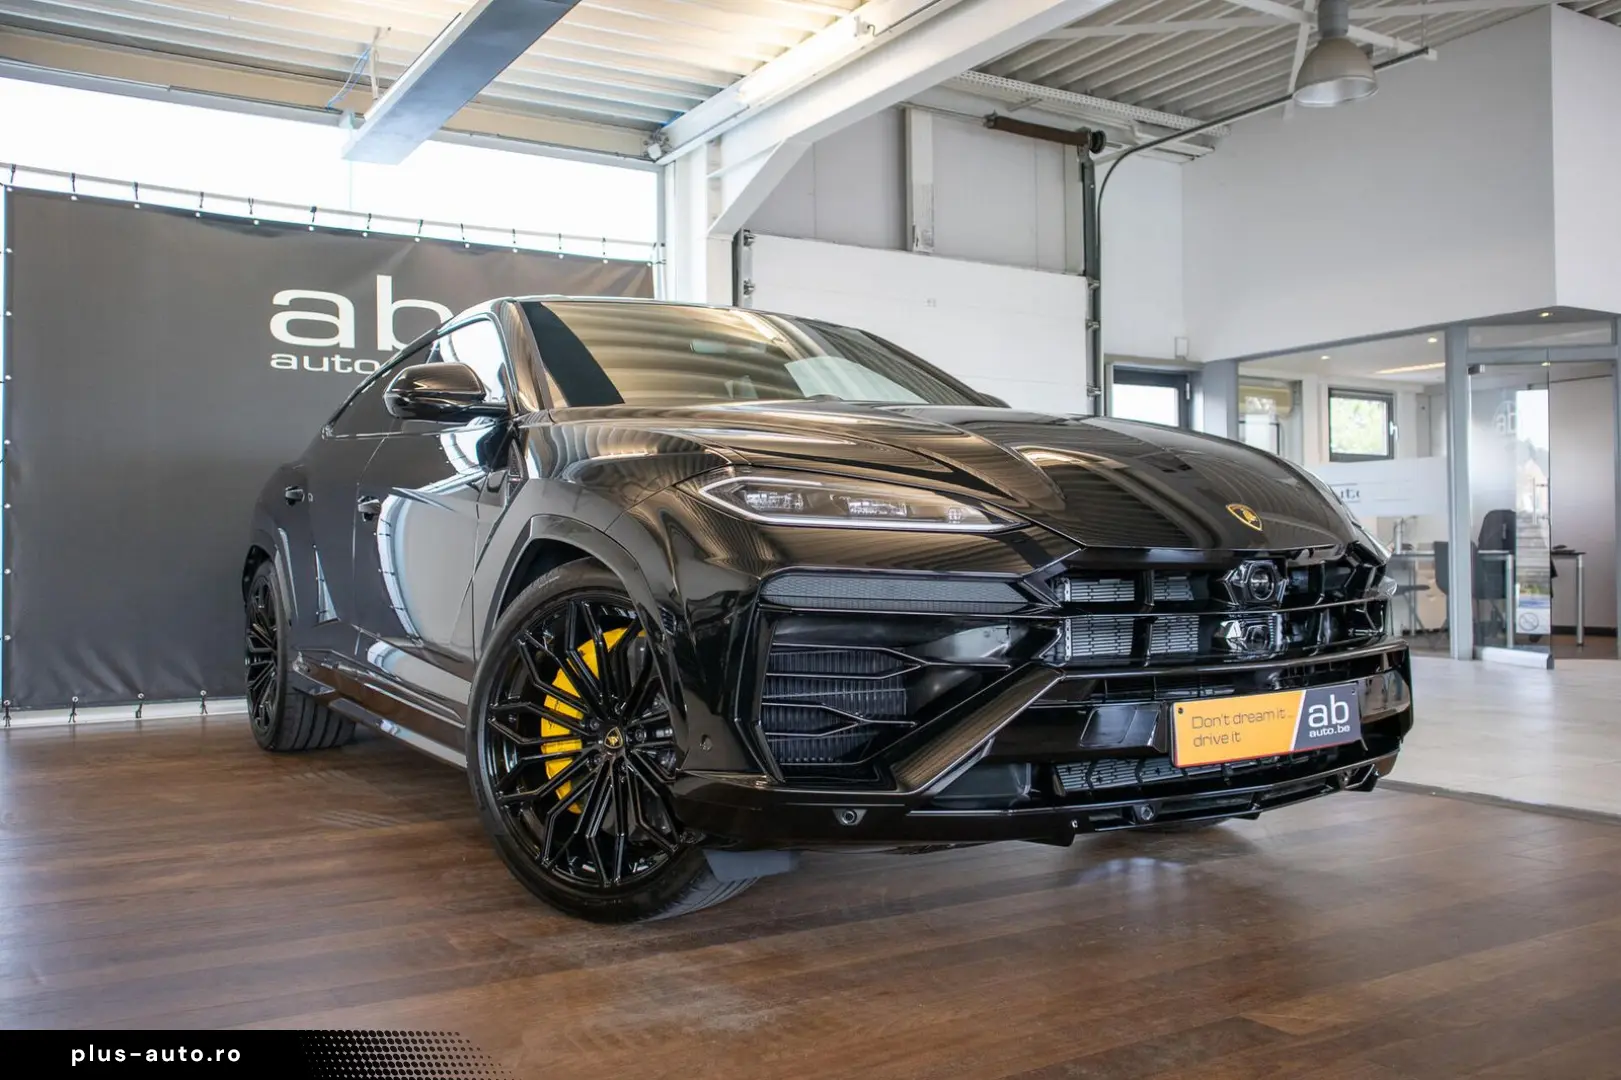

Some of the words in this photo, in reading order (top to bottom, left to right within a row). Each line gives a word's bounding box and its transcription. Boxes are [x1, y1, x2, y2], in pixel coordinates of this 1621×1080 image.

[269, 275, 454, 352] ab
[1191, 713, 1230, 729] Don't
[1233, 710, 1275, 724] dream
[1308, 694, 1350, 727] ab
[1193, 735, 1229, 748] drive
[1231, 731, 1241, 743] it
[1309, 724, 1351, 738] auto.be
